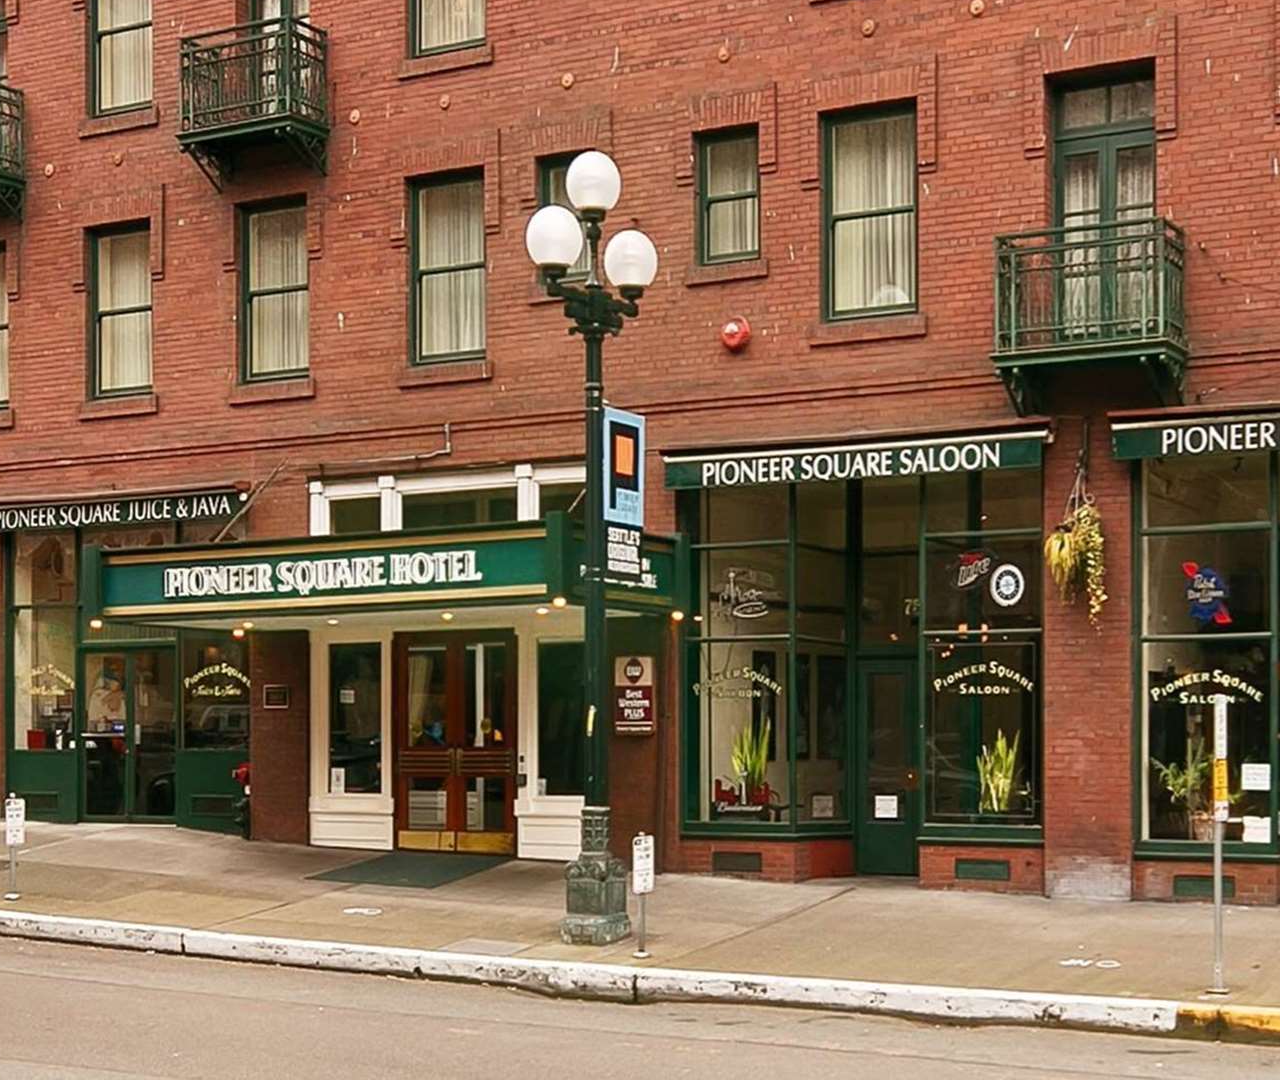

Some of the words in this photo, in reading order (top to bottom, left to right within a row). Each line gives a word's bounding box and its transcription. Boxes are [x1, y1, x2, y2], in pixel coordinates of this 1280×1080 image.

[1161, 421, 1276, 455] PIONEER
[702, 456, 796, 486] PIONEER
[801, 450, 893, 481] SQUARE
[899, 442, 1000, 475] SALOON
[59, 502, 120, 527] SQUARE
[127, 499, 171, 521] JUICE
[176, 498, 188, 518] &
[191, 495, 231, 518] JAVA
[164, 563, 274, 597] PIONEER
[276, 555, 387, 595] SQUARE
[389, 550, 483, 584] HOTEL
